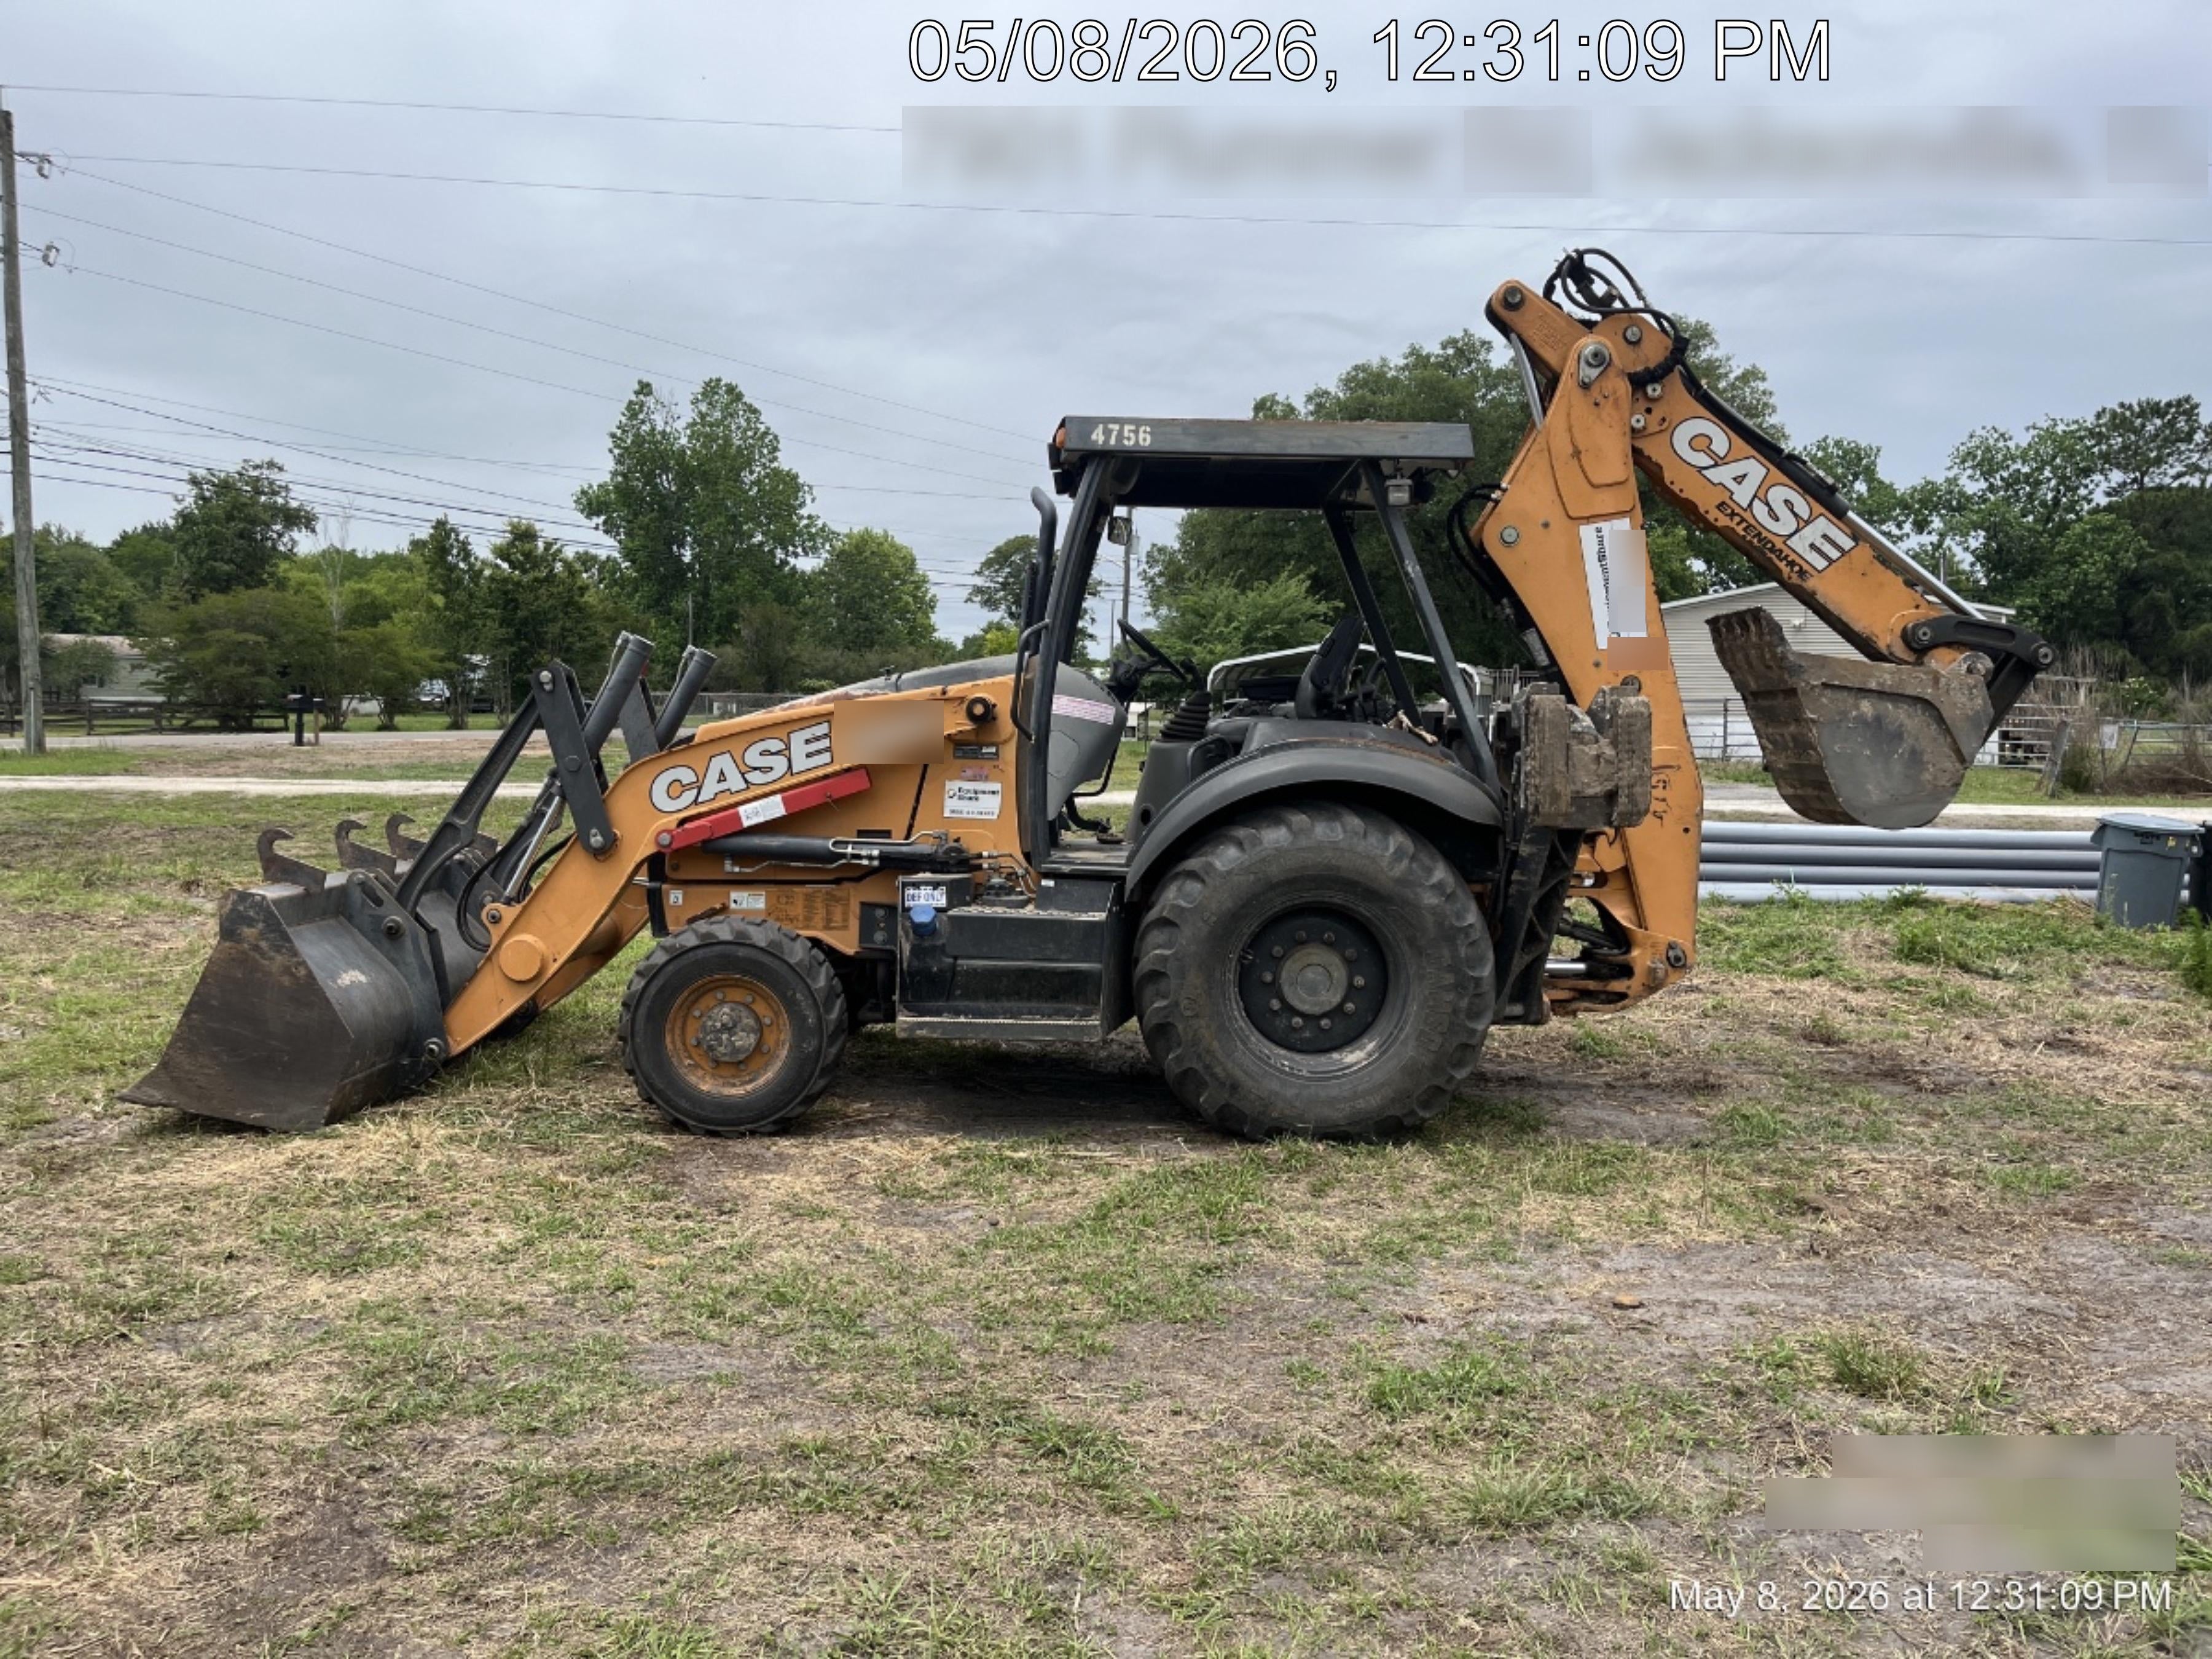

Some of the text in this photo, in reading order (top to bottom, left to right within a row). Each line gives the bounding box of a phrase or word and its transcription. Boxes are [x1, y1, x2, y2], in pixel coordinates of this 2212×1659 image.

[1091, 423, 1151, 447] 4756
[1670, 416, 1858, 573] CASE
[1716, 500, 1814, 581] EXTENDAHOE
[649, 720, 834, 814] CASE
[906, 892, 944, 902] DEF ONLY
